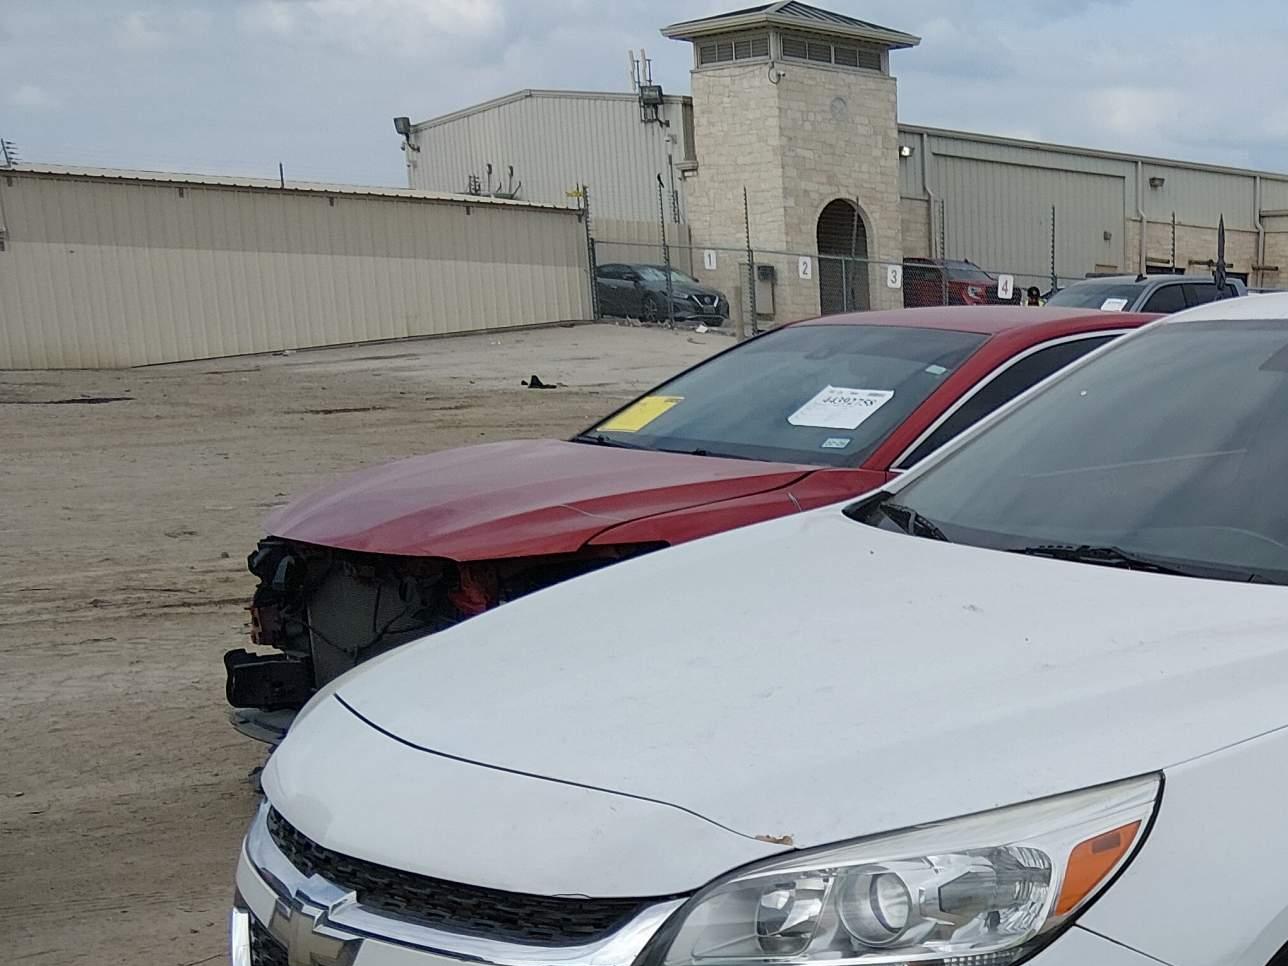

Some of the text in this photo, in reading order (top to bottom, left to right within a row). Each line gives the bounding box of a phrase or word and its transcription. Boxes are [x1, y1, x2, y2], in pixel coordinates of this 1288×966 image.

[706, 253, 712, 267] 1
[802, 261, 809, 275] 2
[890, 270, 898, 284] 3
[1000, 280, 1009, 296] 4
